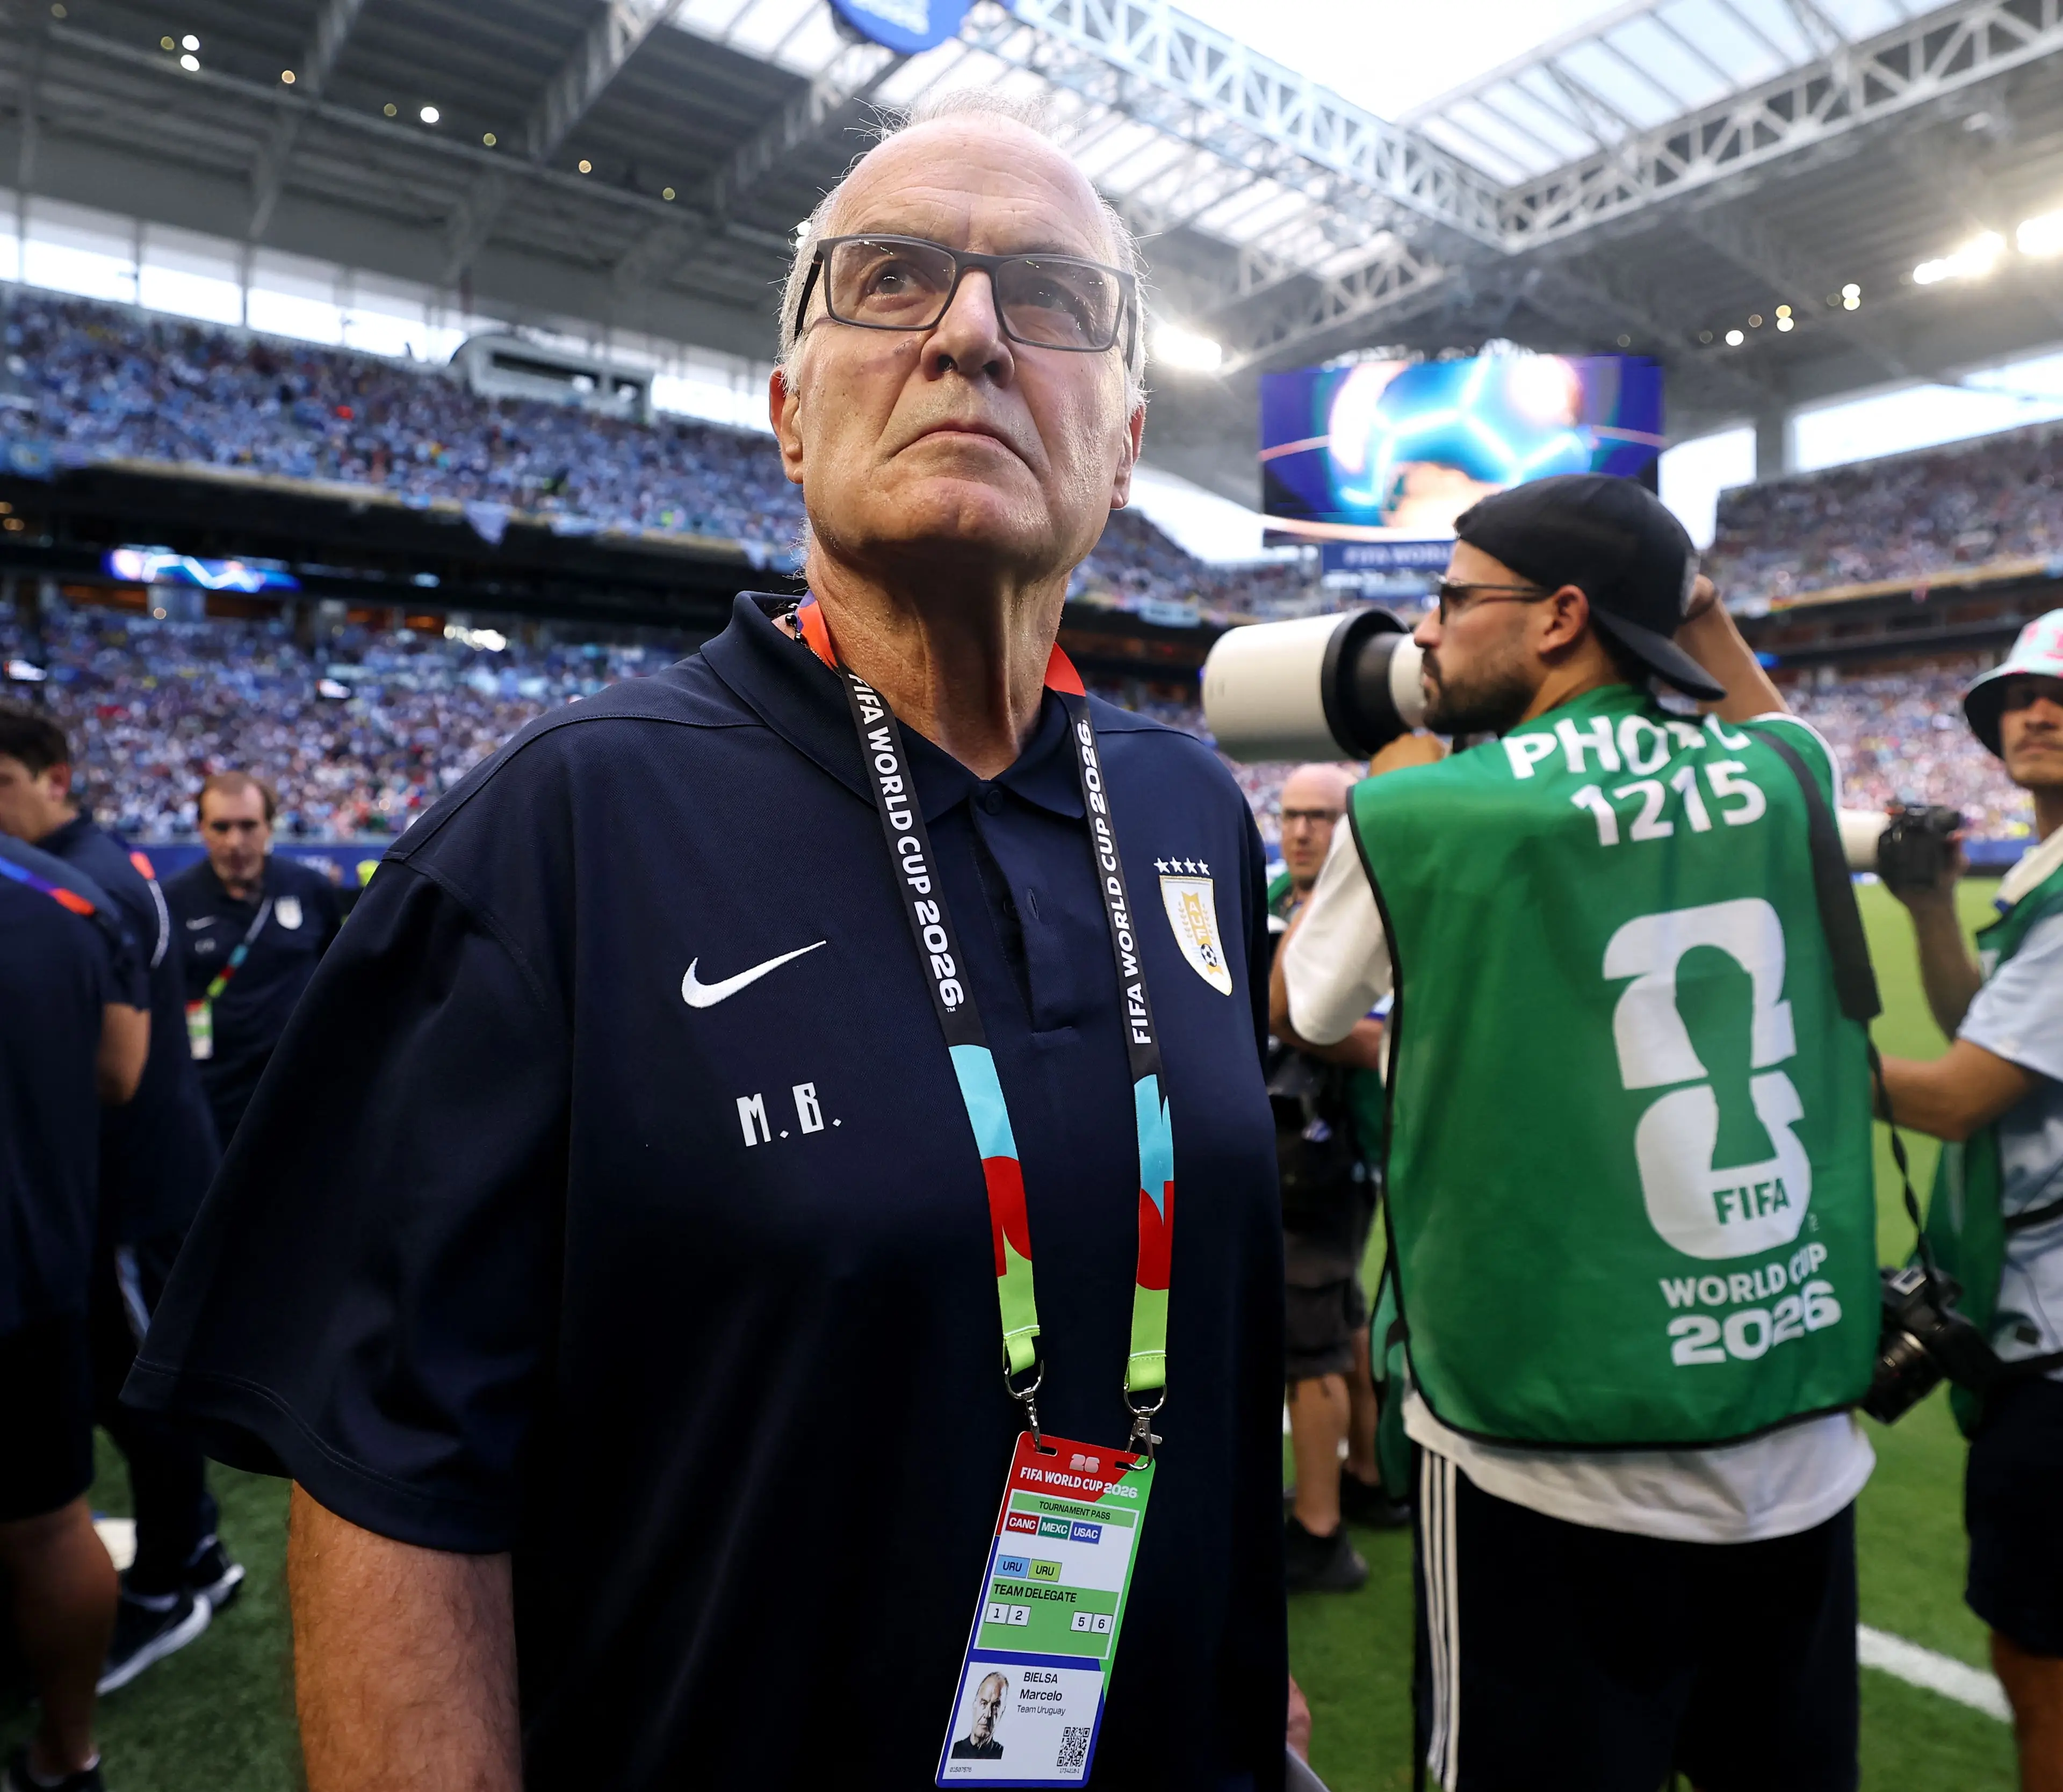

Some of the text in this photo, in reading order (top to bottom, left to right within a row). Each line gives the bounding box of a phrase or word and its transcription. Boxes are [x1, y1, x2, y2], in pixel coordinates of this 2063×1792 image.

[1393, 541, 1452, 566] WORL
[1570, 759, 1767, 847] 1215
[848, 673, 884, 725] FIFA
[867, 726, 913, 830] WORLD
[897, 836, 931, 894] CUP
[914, 900, 964, 1007] 2026
[1077, 722, 1151, 1044] FIFA WORLD CUP 2026
[1712, 1177, 1791, 1225] FIFA
[1658, 1242, 1828, 1308] WORLD CUP
[1667, 1279, 1842, 1367] 2026
[1069, 1454, 1100, 1473] 26
[1020, 1466, 1138, 1498] FIFA WORLD CUP 2026
[1040, 1501, 1110, 1520] TOURNAMENT PASS
[1009, 1518, 1036, 1529] CANC
[1041, 1522, 1068, 1534] MEXC
[1073, 1527, 1098, 1539] USAC
[1002, 1560, 1022, 1572] URU
[1036, 1565, 1055, 1576] URU
[994, 1584, 1077, 1602] TEAM DELEGATE
[994, 1608, 999, 1618] 1
[1015, 1610, 1023, 1621] 2
[1078, 1617, 1085, 1627] 5
[1098, 1619, 1105, 1629] 6
[1023, 1672, 1058, 1683] BIELSA
[1020, 1689, 1062, 1701] Marcelo
[1017, 1705, 1066, 1716] Team Uruguay
